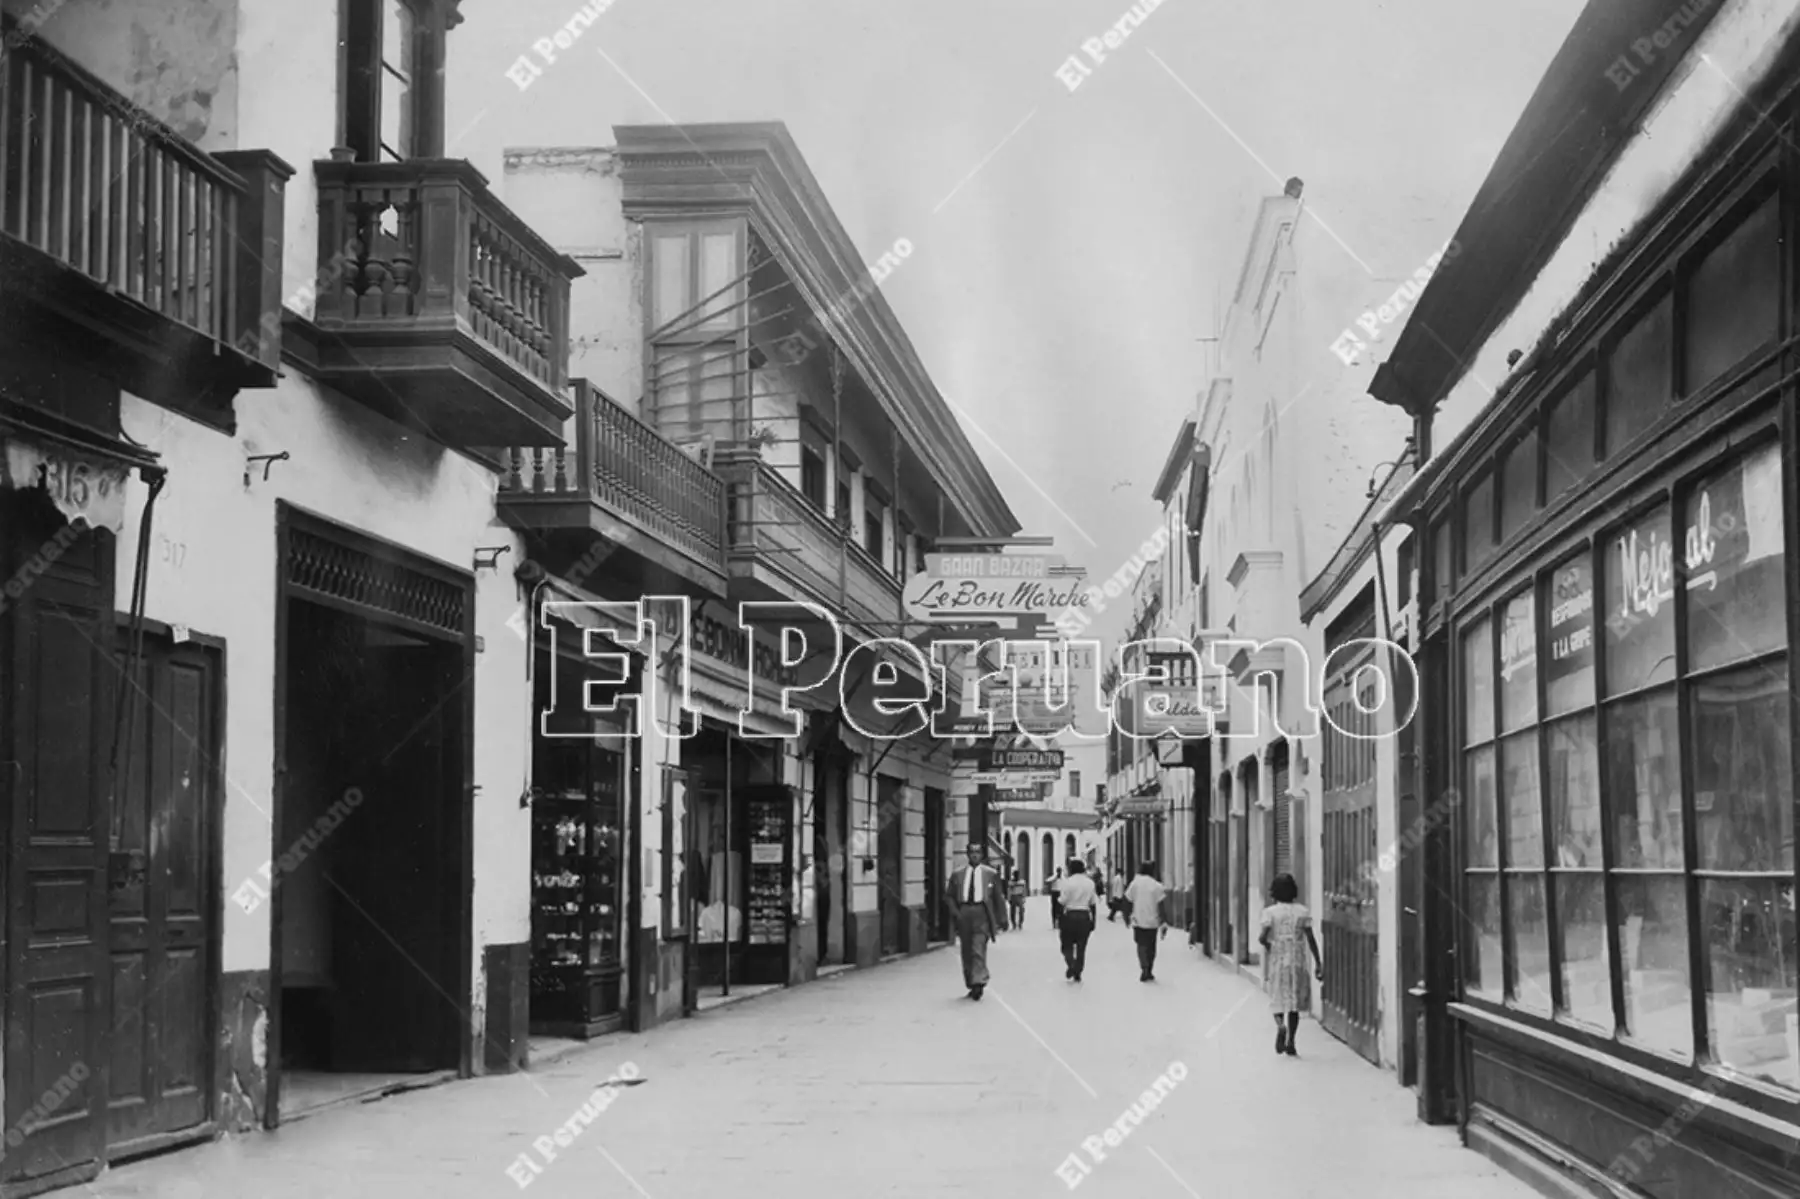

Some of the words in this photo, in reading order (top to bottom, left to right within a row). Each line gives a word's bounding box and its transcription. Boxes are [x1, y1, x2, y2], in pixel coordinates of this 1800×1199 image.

[941, 556, 985, 577] GRAN
[989, 556, 1045, 577] BAZAR
[1620, 491, 1715, 618] Mejoal
[910, 579, 950, 609] Le
[952, 579, 1004, 609] Bon
[1010, 577, 1090, 611] Marche
